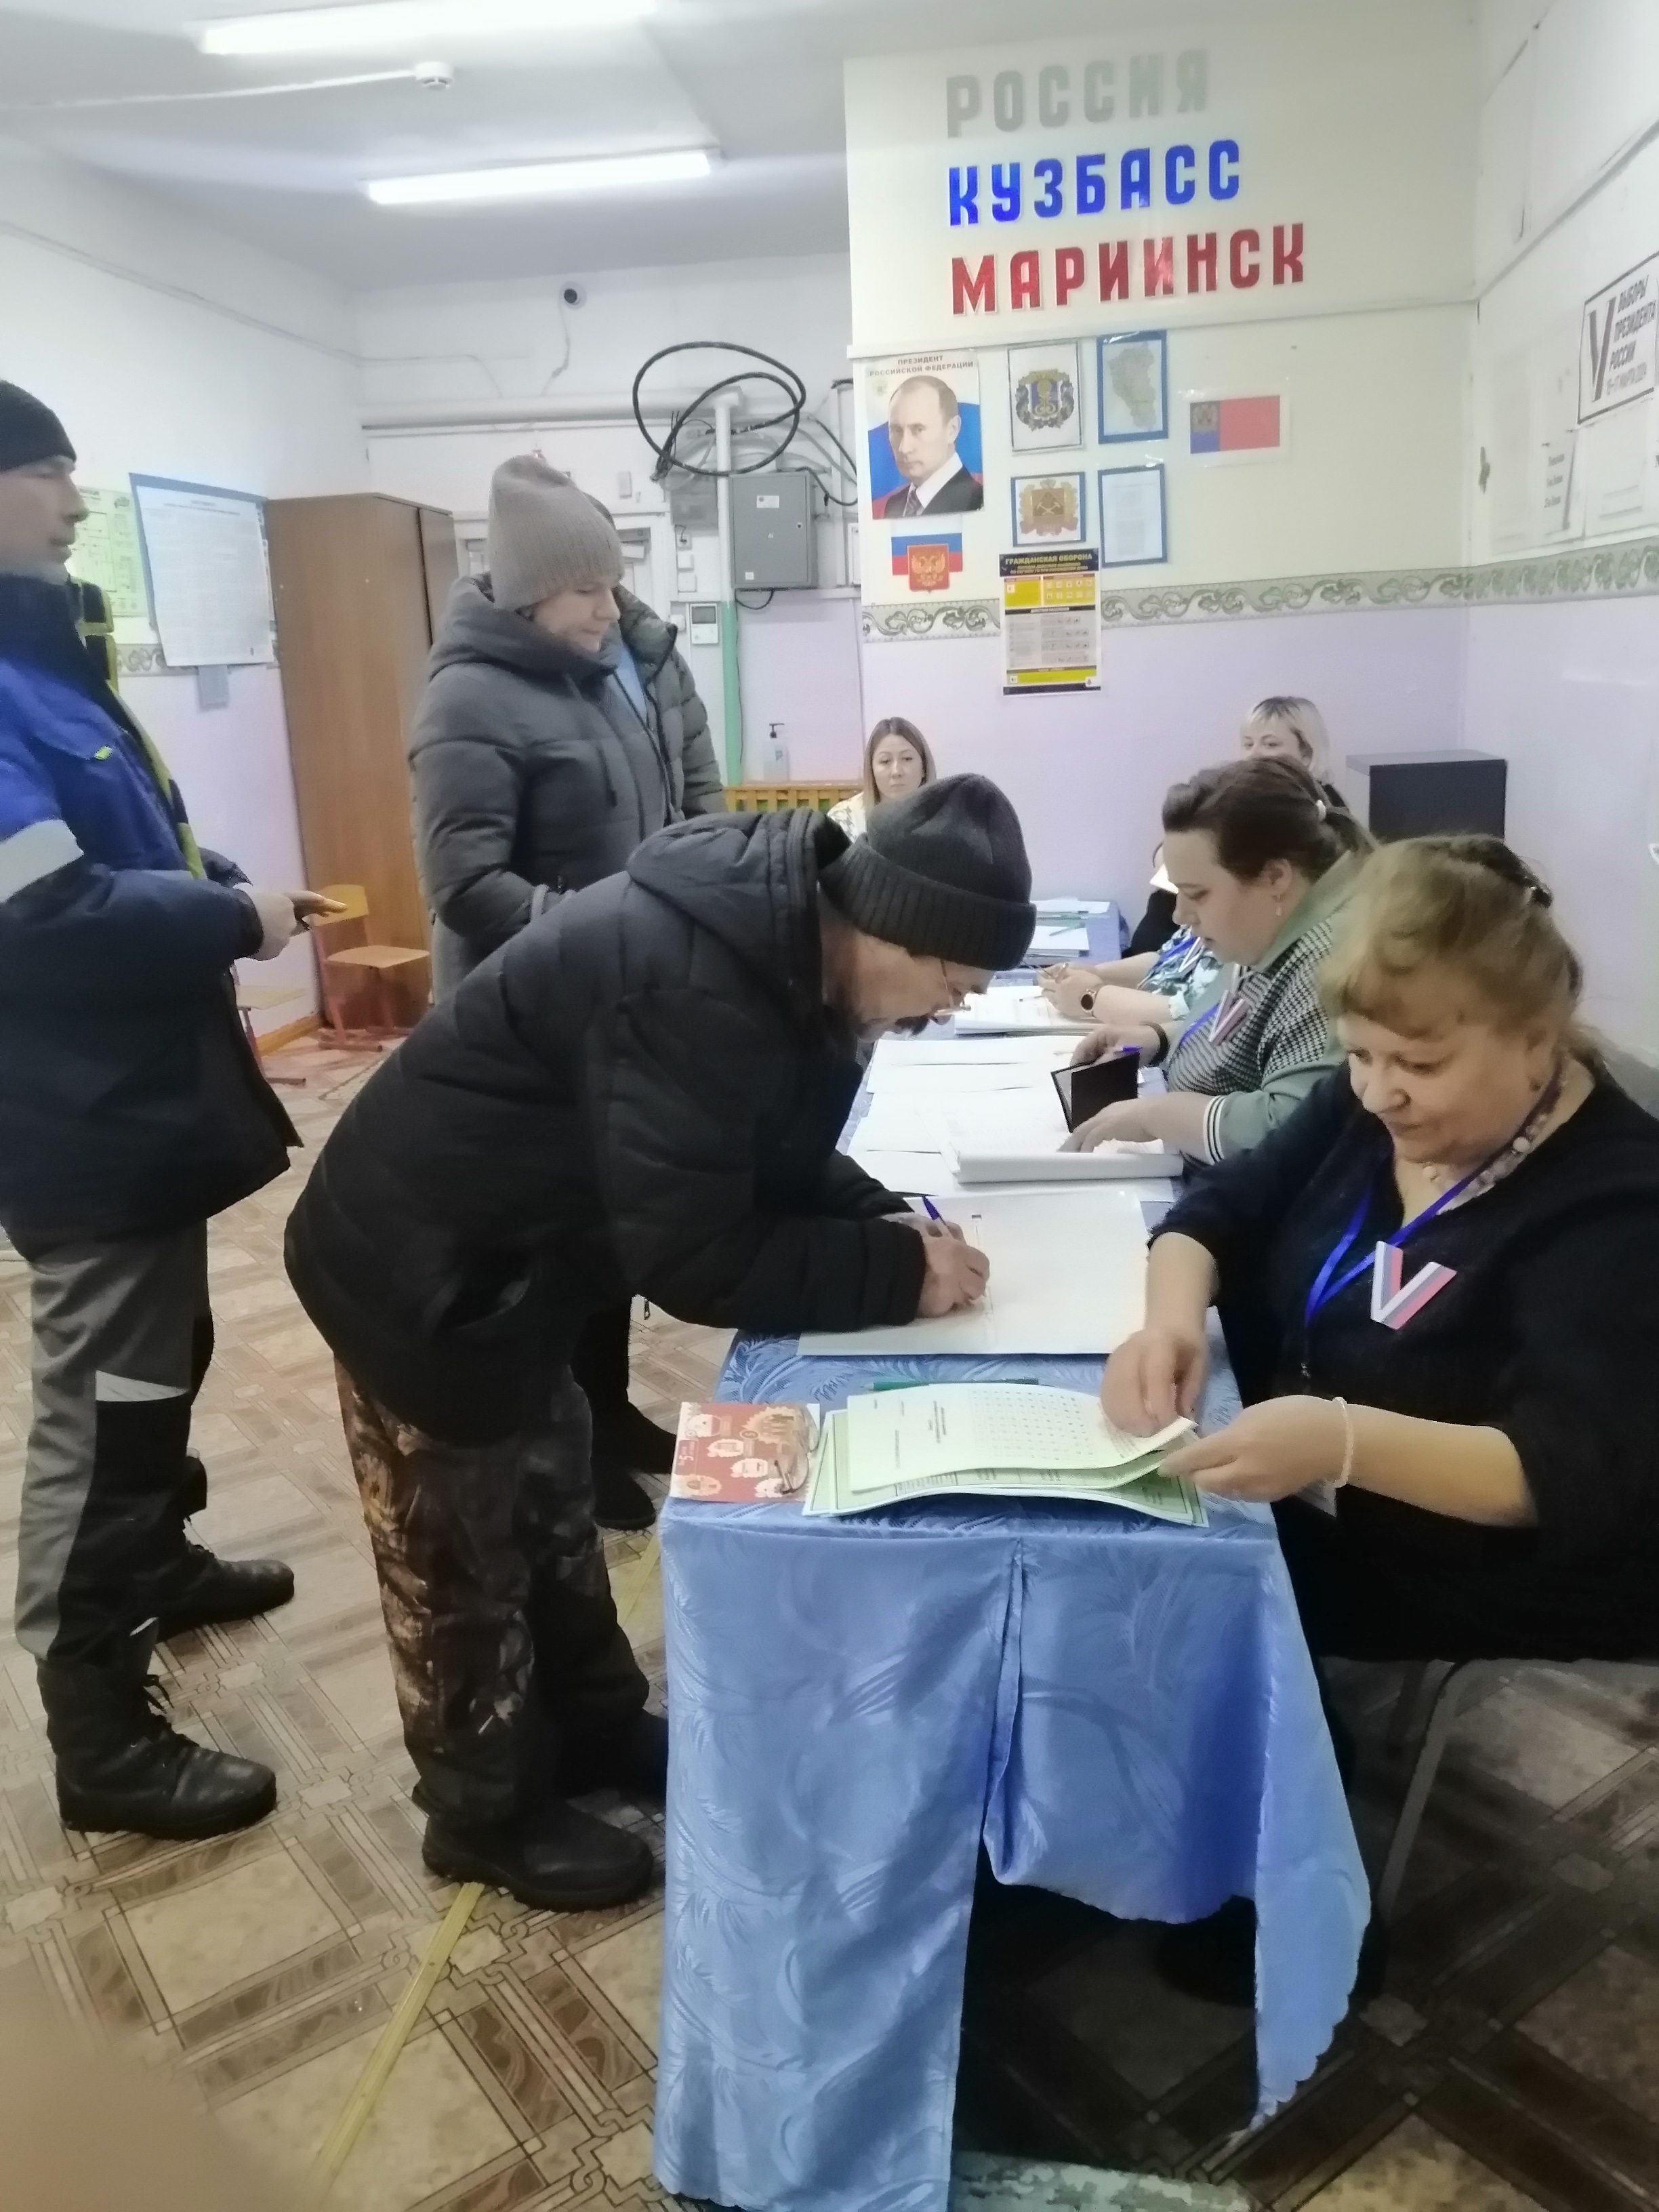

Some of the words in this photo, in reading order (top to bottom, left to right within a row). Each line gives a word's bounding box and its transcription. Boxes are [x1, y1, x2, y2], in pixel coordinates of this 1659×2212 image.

[946, 49, 1208, 138] РОССИЯ
[949, 140, 1240, 227] КУЗБАСС
[951, 222, 1305, 316] МАРИИНСК
[869, 365, 922, 377] РОССИЙСКОЙ
[924, 361, 974, 372] ФЕДЕРАЦИИ
[897, 355, 943, 365] ПРЕЗИДЕНТ
[1005, 556, 1058, 565] ГРАЖДАНСКАЯ
[1059, 553, 1092, 562] ОБОРОНА
